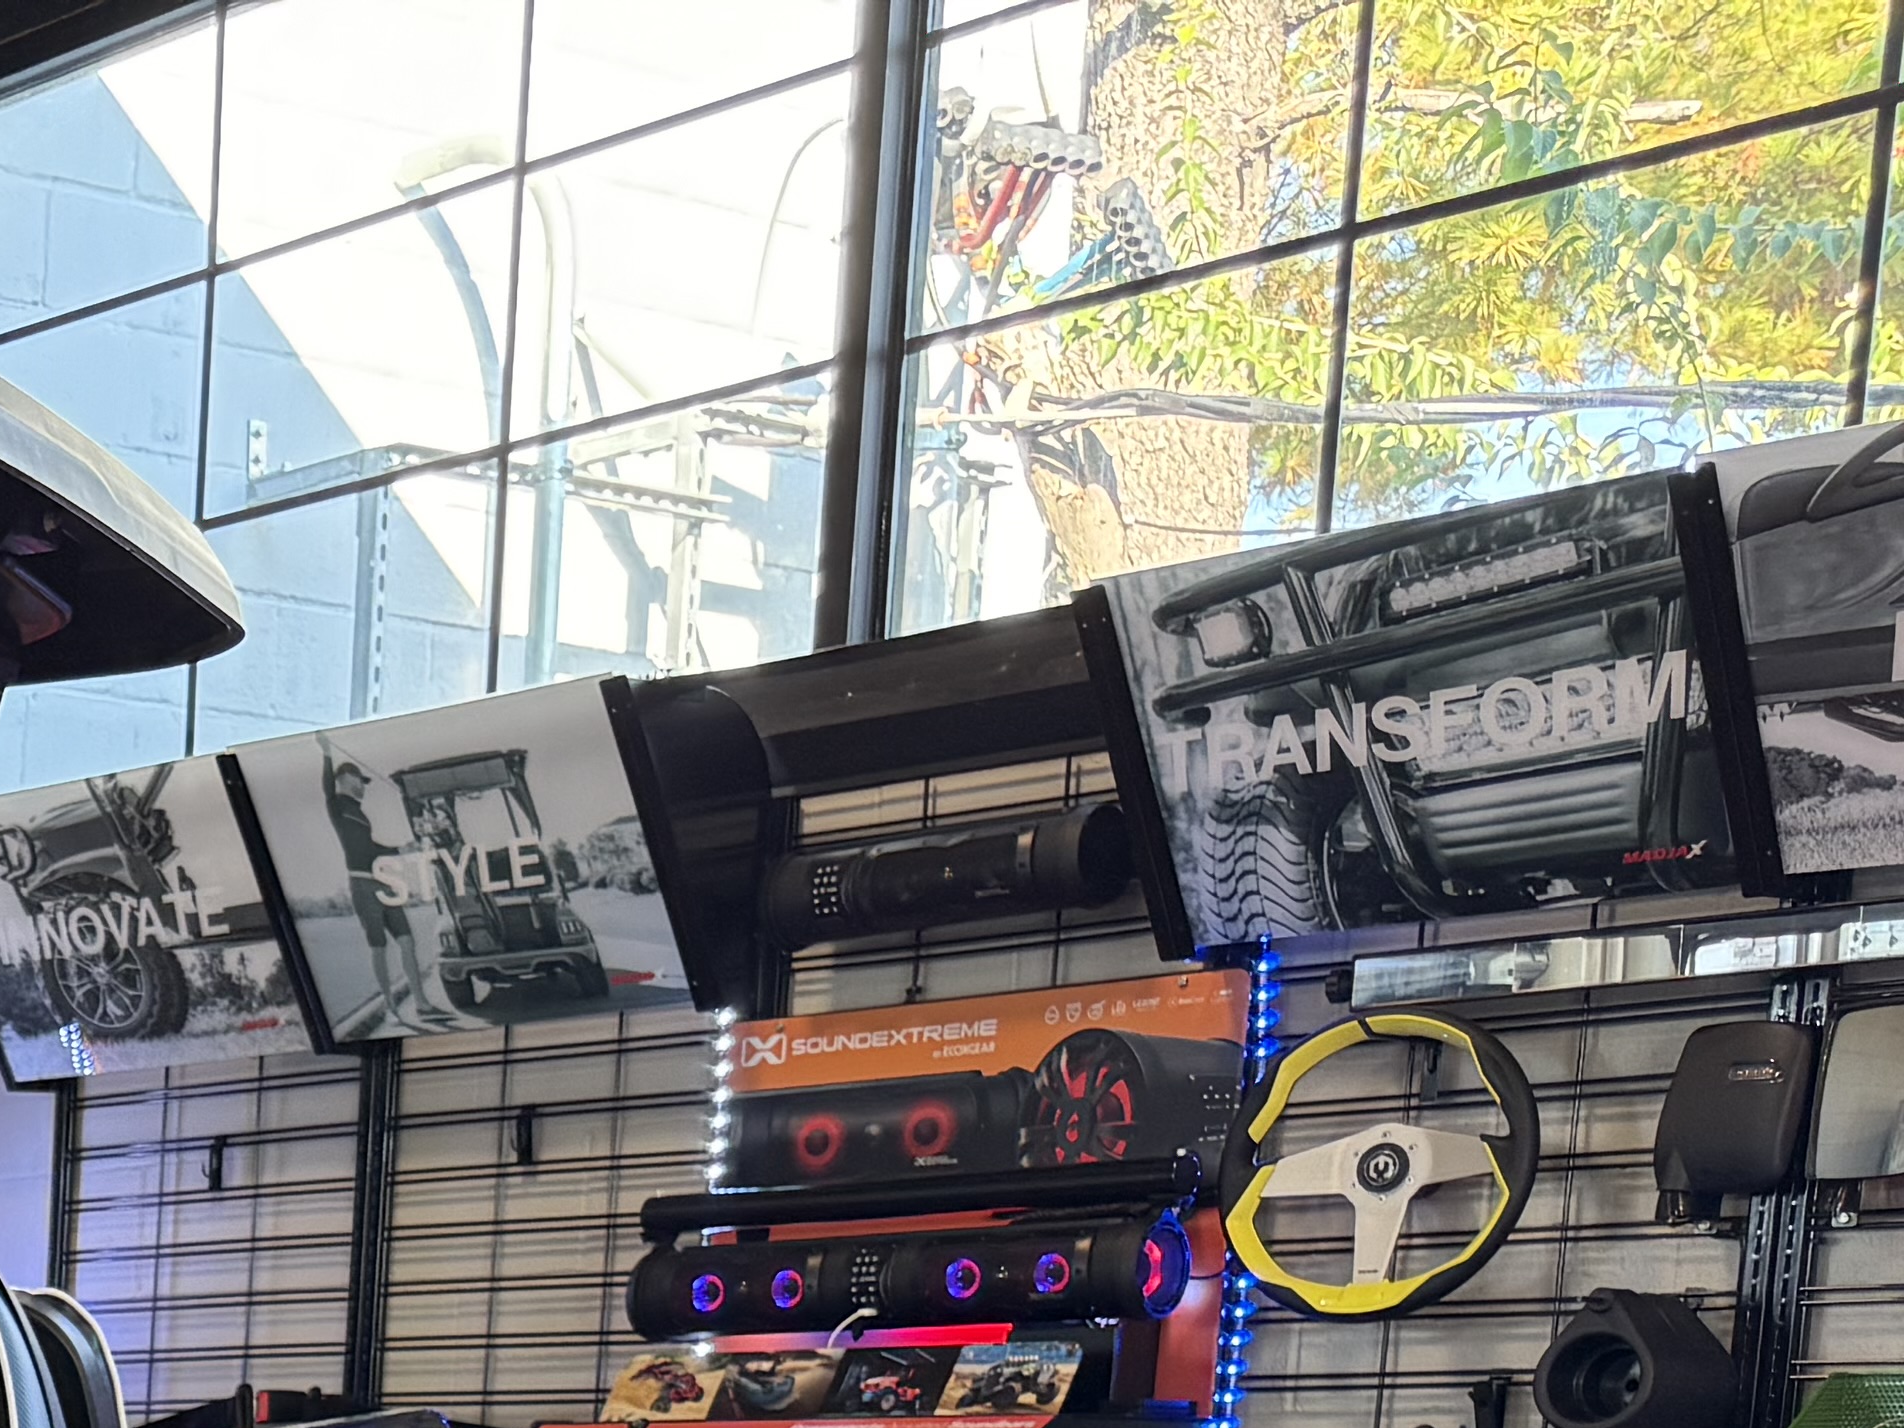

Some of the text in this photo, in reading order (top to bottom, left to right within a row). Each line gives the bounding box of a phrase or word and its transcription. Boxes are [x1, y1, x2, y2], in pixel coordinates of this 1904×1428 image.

[1153, 649, 1689, 795] TRANSFORM
[370, 839, 547, 908] STYLE
[792, 1018, 998, 1056] SOUNDEXTREME
